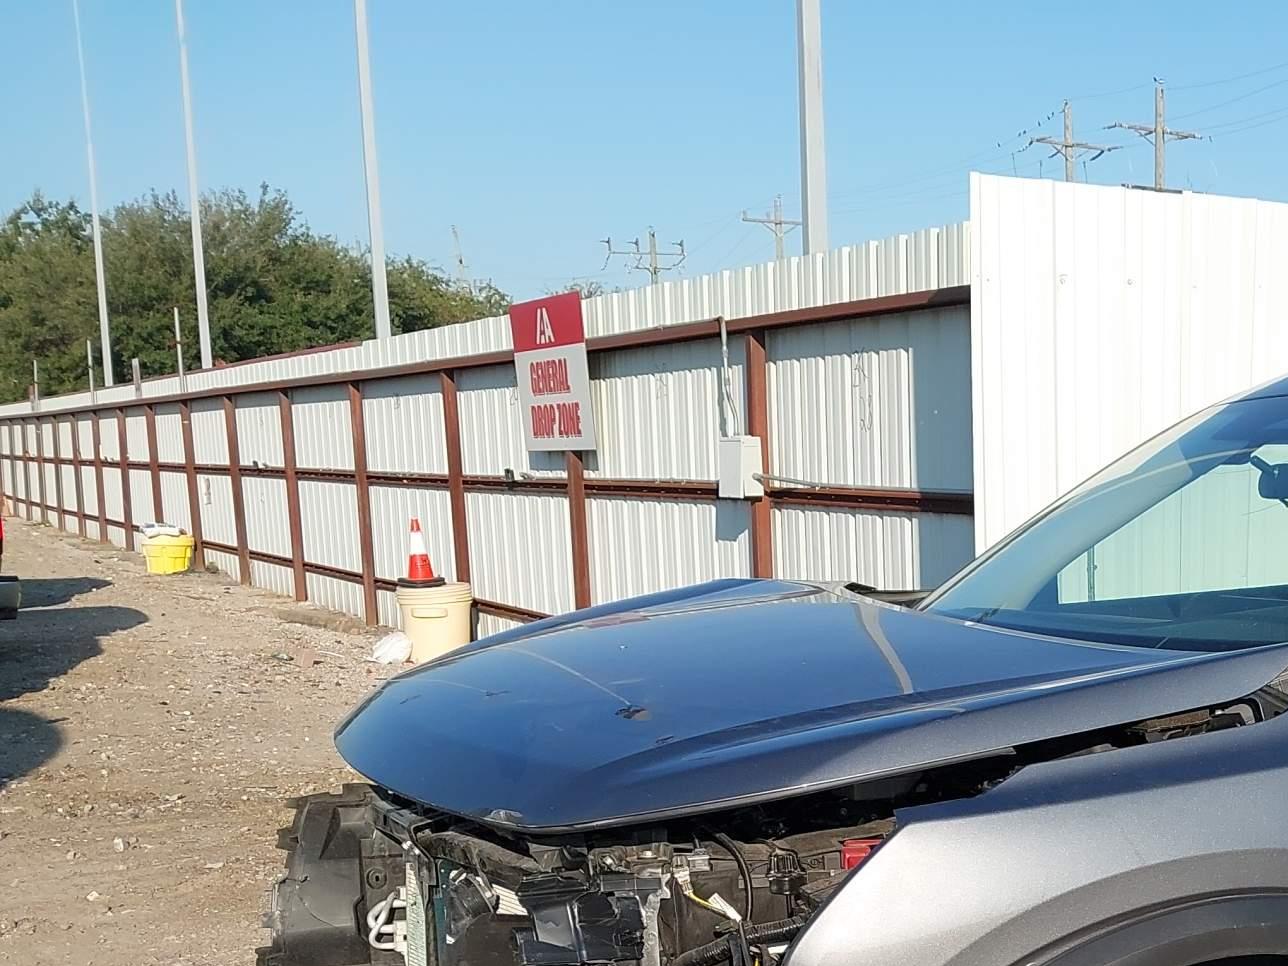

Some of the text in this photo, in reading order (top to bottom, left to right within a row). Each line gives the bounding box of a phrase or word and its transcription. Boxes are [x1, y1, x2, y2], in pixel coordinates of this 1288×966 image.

[529, 358, 571, 396] GENERAL
[530, 401, 582, 439] DROP ZONE
